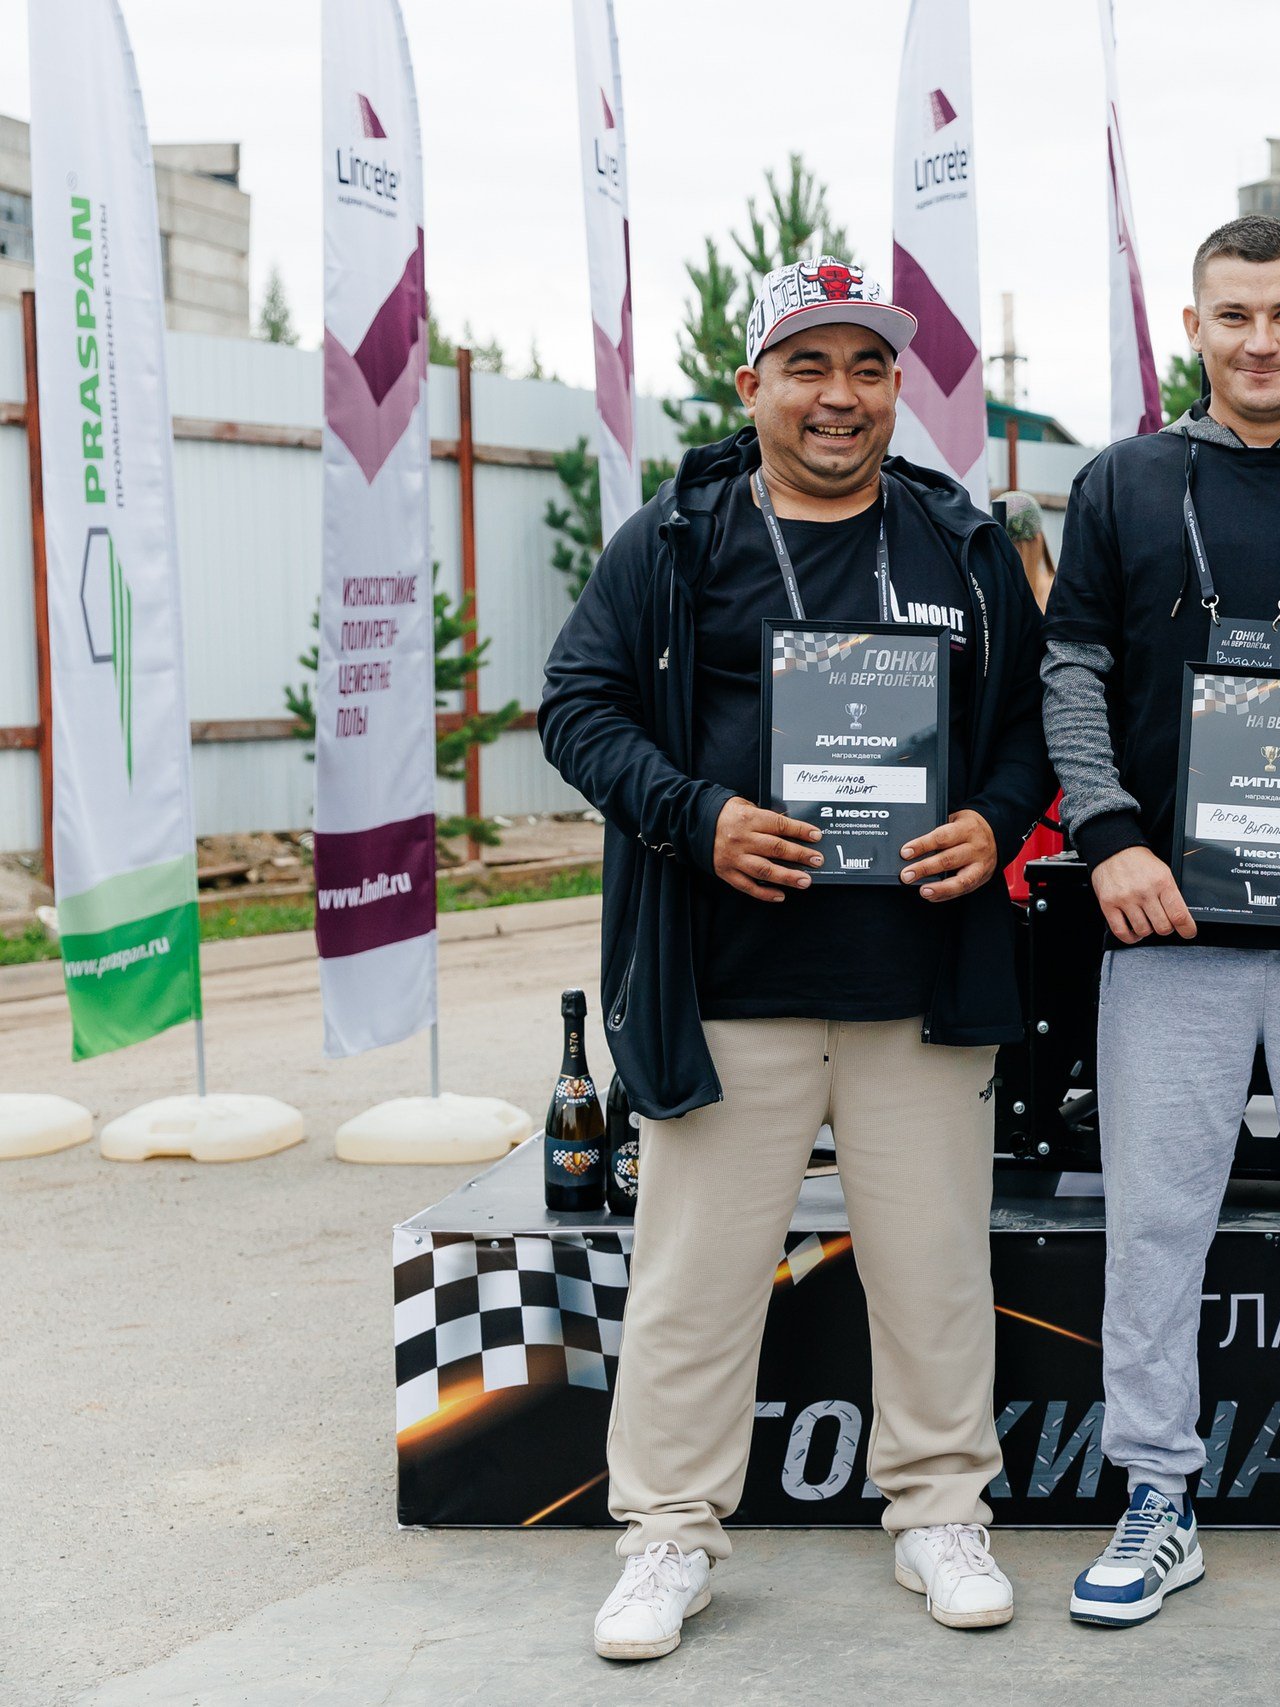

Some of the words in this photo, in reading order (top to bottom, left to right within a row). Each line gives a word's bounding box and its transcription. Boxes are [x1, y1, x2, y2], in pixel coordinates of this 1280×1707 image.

[336, 147, 398, 201] Lincrete
[914, 141, 968, 192] Lincrete
[71, 196, 106, 504] PRASPAN
[874, 571, 964, 632] LINOLIT
[1230, 630, 1265, 642] ГОНКИ
[862, 649, 937, 672] ГОНКИ
[829, 672, 850, 686] НА
[850, 670, 937, 688] ВЕРТОЛЁТАХ
[1246, 715, 1264, 728] НА
[816, 734, 898, 747] ДИПЛОМ
[832, 752, 882, 760] награждается
[820, 806, 833, 818] 2
[1234, 846, 1240, 856] 1
[570, 1032, 578, 1058] 1870
